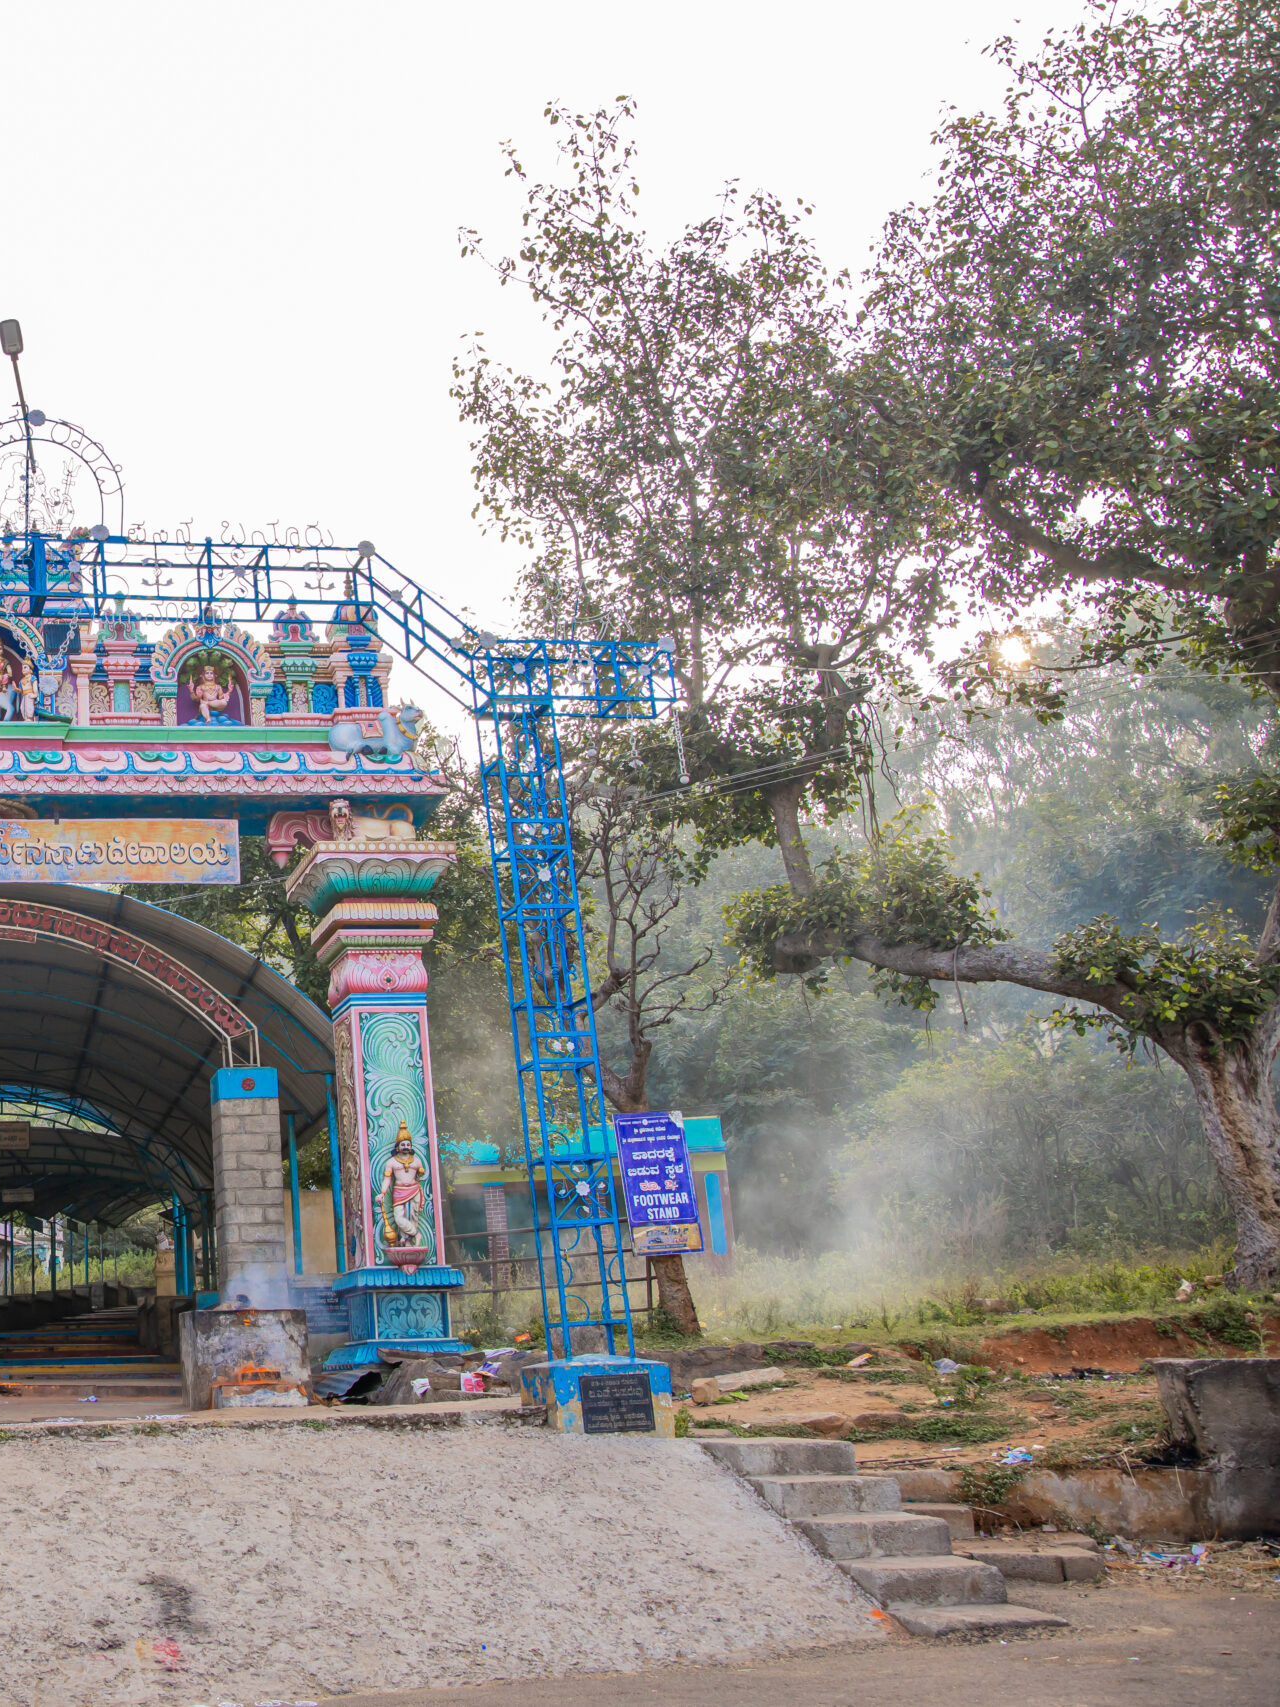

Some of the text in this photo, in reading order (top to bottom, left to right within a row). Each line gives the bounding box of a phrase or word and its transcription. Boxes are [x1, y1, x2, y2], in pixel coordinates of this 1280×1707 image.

[632, 1147, 676, 1162] ಪಾದರಕ್ಷೆ
[665, 1163, 684, 1179] ಸ್ಥಳ
[633, 1192, 689, 1207] FOOTWEAR
[647, 1207, 680, 1220] STAND
